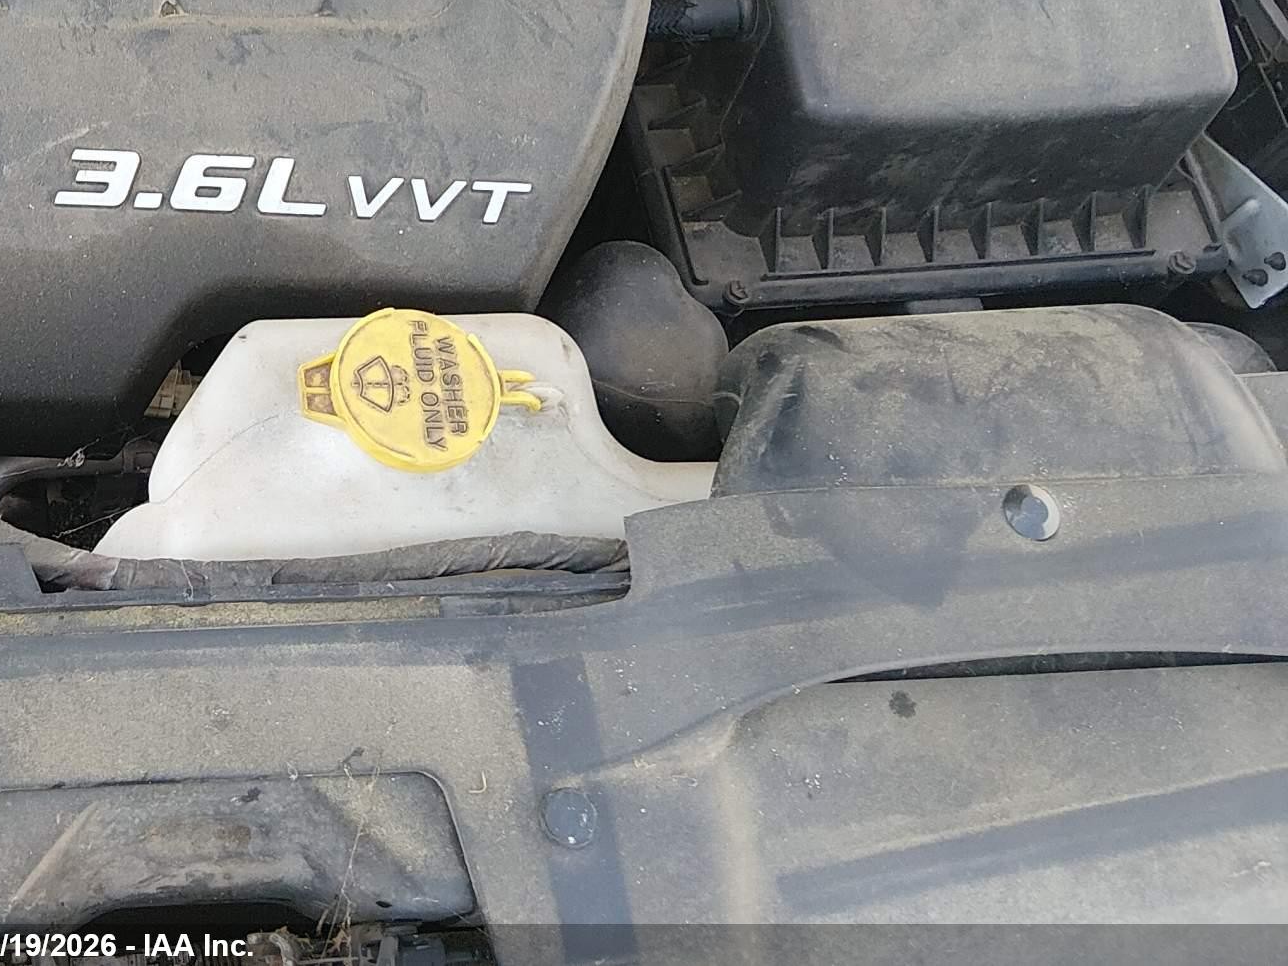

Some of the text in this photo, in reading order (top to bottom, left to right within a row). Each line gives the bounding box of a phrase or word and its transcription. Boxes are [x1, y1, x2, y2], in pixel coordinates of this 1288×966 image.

[53, 148, 533, 224] 3.6L VVT
[409, 319, 448, 451] FLUID ONLY
[435, 335, 469, 436] WASHER
